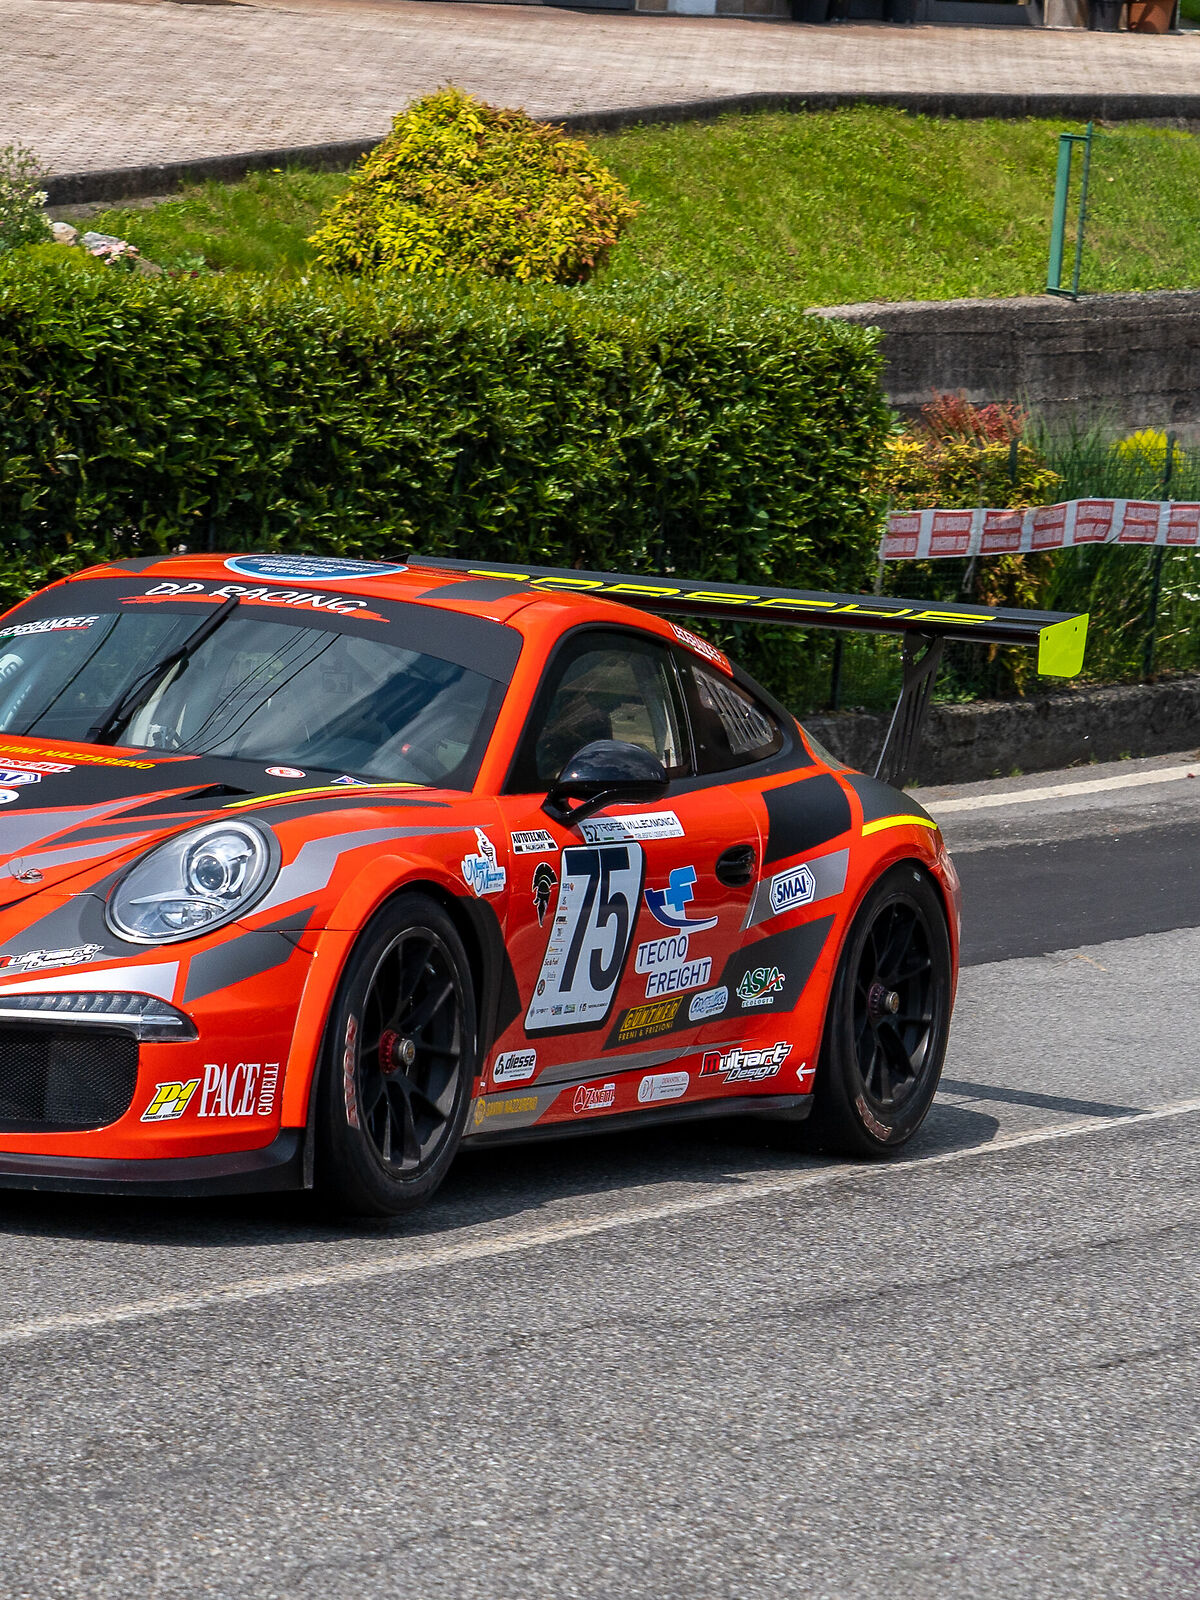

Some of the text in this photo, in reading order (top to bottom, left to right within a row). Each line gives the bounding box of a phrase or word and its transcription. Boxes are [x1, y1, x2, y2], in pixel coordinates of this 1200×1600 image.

[145, 582, 368, 614] DP RACING
[39, 750, 156, 770] NAZZARENO
[624, 817, 678, 830] VALLECAMONICA
[777, 875, 807, 903] SMAI
[558, 846, 631, 993] 75
[638, 935, 688, 967] TECNO
[646, 961, 711, 997] FREIGHT
[737, 967, 785, 998] ASIA
[624, 998, 680, 1030] GÜNTHER
[618, 1030, 638, 1041] FRENI
[645, 1022, 673, 1036] FRIZIONI
[504, 1054, 536, 1070] diesse
[728, 1064, 780, 1081] Design
[197, 1062, 261, 1117] PACE
[257, 1062, 280, 1116] GIOIELLI
